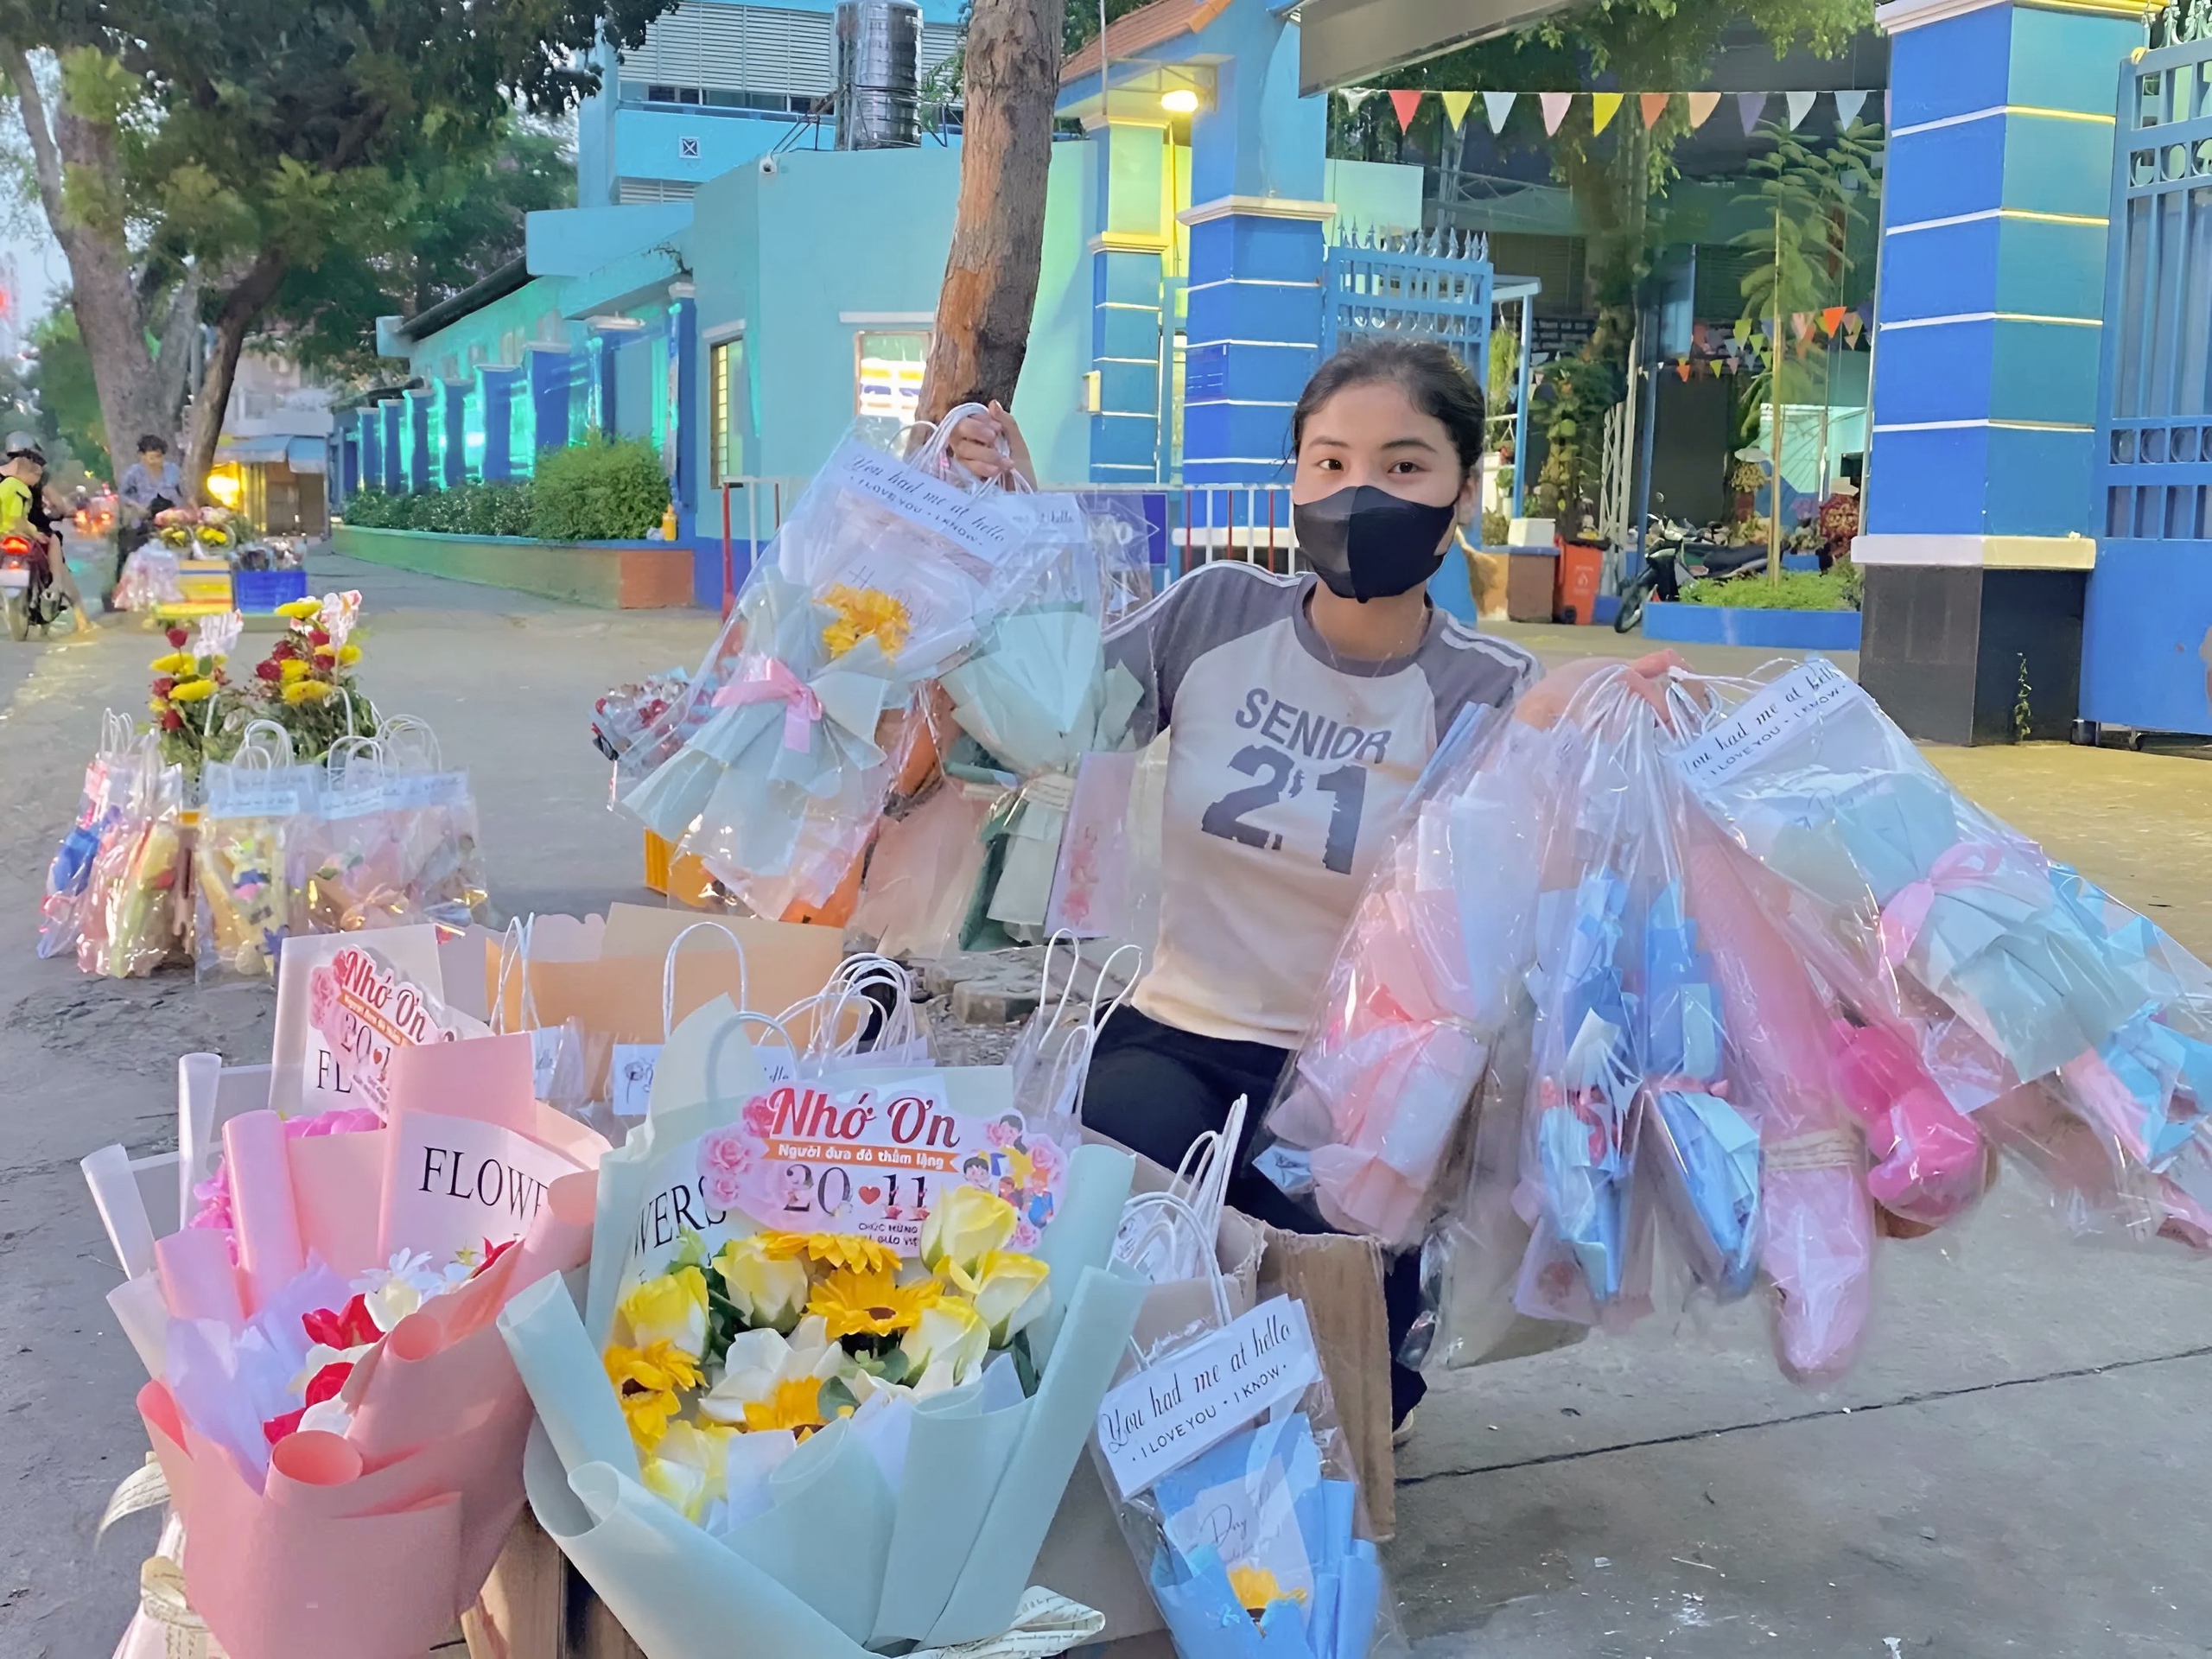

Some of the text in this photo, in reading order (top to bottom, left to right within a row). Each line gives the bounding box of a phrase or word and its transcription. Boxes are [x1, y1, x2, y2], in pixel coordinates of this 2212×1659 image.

[887, 471, 925, 494] had
[971, 516, 1005, 542] hello
[899, 499, 923, 513] YOU
[1235, 688, 1392, 764] SENIOR
[1715, 721, 1750, 751] had
[1756, 703, 1780, 727] me
[1785, 687, 1803, 702] at
[1718, 747, 1754, 772] LOVE
[1752, 727, 1781, 746] YOU
[1201, 744, 1368, 875] 21
[769, 1087, 961, 1148] Nhớ Ơn
[783, 1163, 854, 1217] 20
[1102, 1314, 1291, 1454] You had me at hello
[1151, 1427, 1187, 1453] LOVE
[1187, 1405, 1217, 1432] YOU
[1243, 1370, 1281, 1399] KNOW
